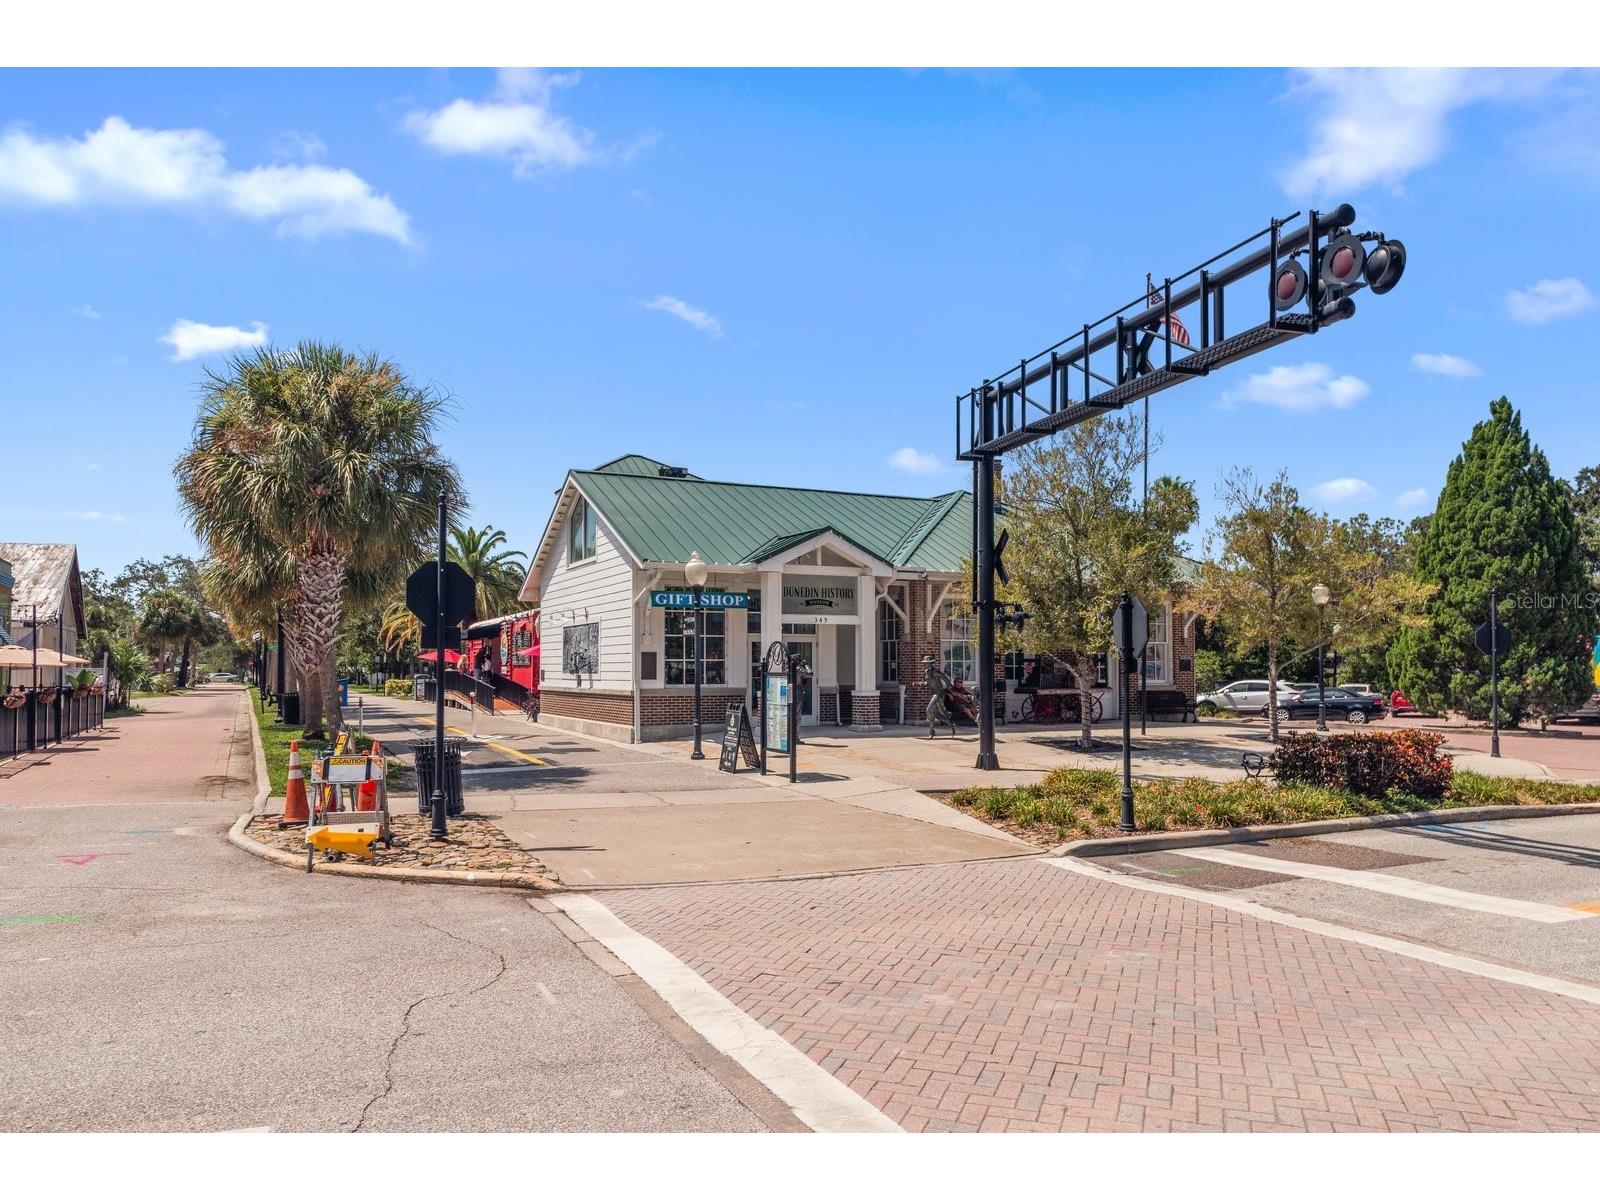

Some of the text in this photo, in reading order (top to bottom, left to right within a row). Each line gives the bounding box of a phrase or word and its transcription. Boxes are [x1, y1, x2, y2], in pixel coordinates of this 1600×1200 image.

[783, 586, 855, 599] DUNEDIN HISTORY
[655, 593, 744, 606] GIFT SHOP
